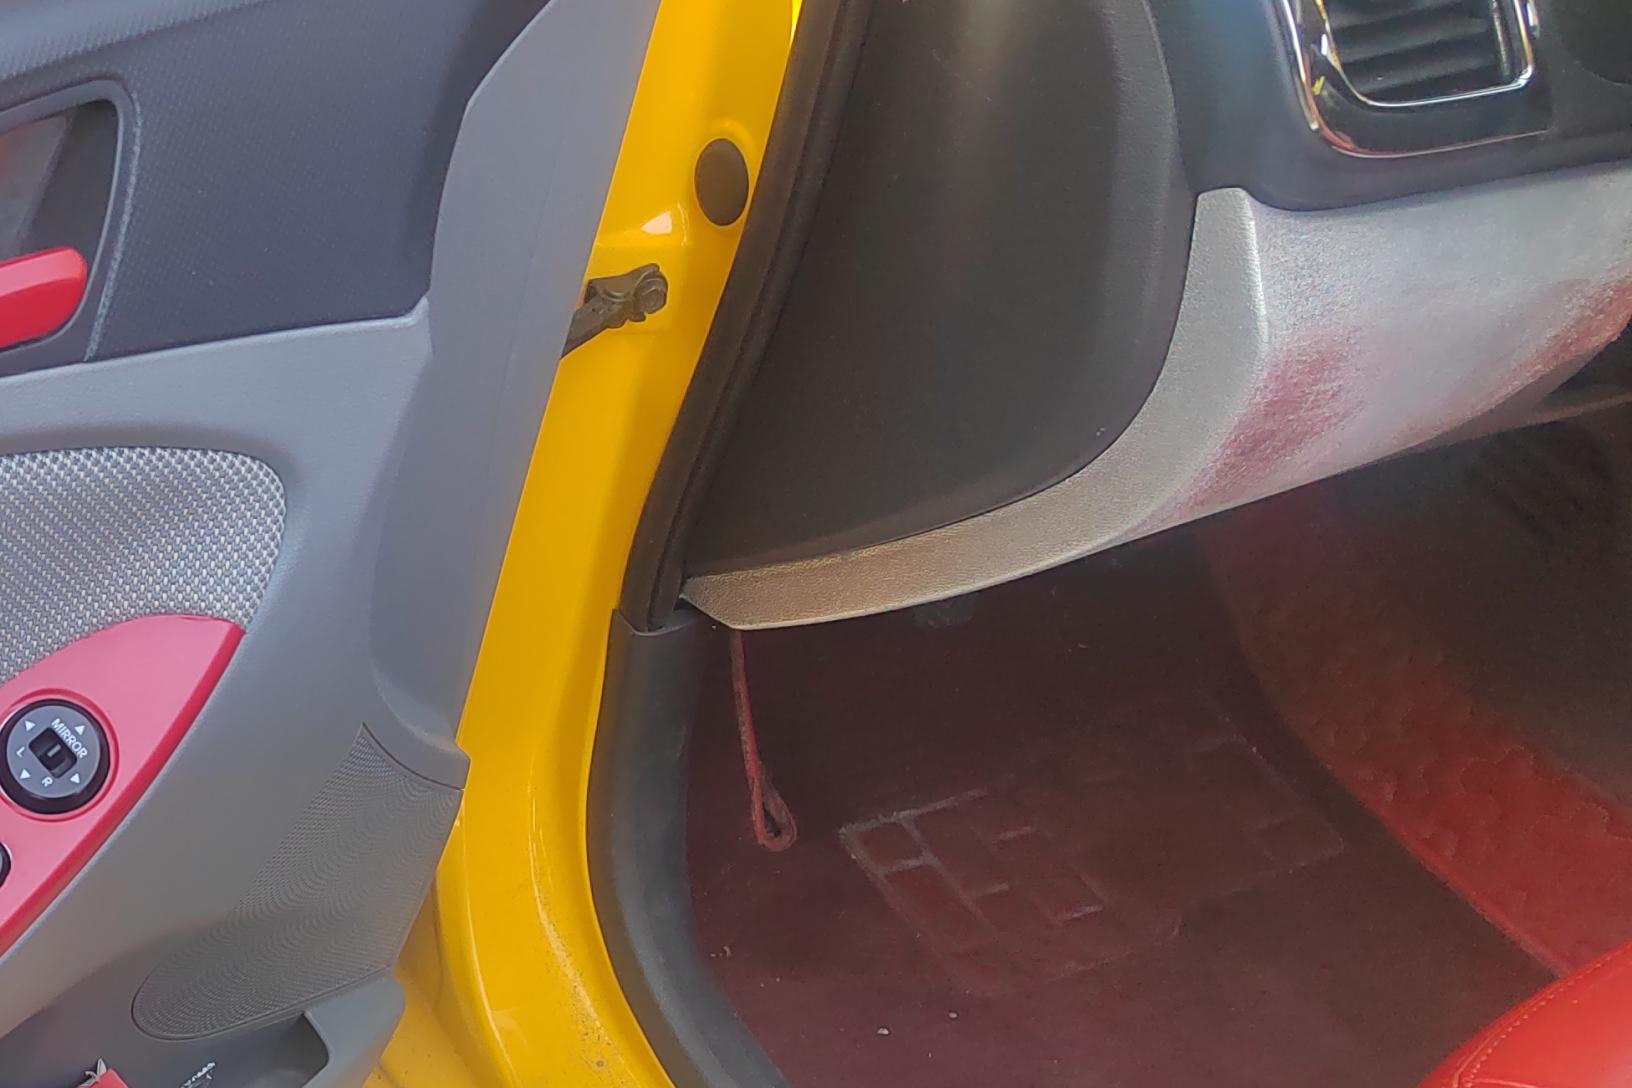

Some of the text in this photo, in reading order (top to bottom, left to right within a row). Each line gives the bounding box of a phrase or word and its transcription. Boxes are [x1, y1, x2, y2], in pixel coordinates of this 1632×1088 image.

[51, 718, 88, 758] MIRROR
[16, 746, 25, 758] L
[41, 776, 53, 787] R
